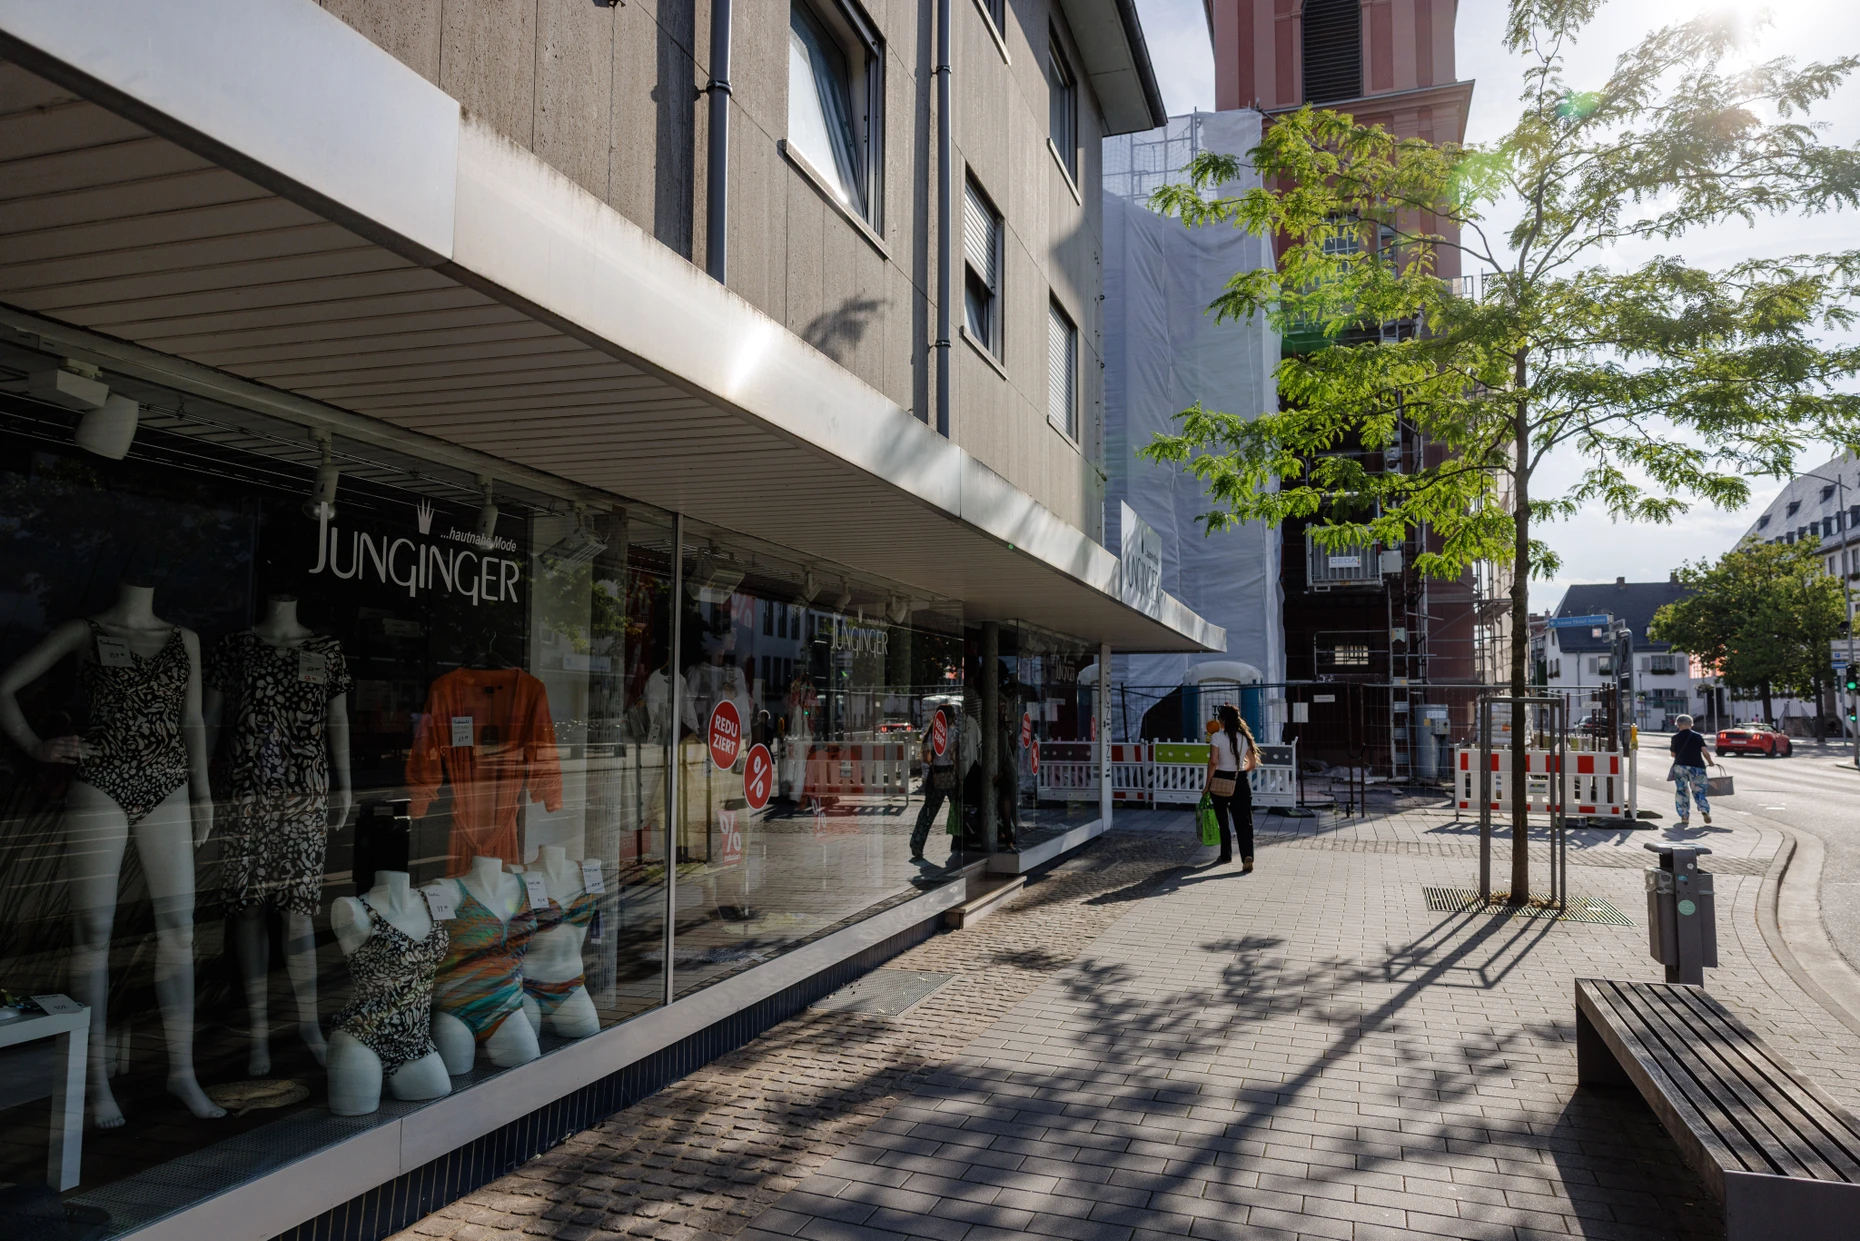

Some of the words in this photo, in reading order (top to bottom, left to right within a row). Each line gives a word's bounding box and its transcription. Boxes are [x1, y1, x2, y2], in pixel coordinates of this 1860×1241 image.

[308, 501, 520, 607] JUNGINGER
[493, 532, 517, 553] Mode
[830, 612, 889, 659] JUNGINGER
[714, 714, 738, 737] REDU
[934, 730, 945, 748] ZIERT
[935, 717, 946, 737] REDU
[712, 733, 736, 756] ZIERT
[749, 755, 768, 800] %
[811, 796, 827, 830] %
[719, 813, 742, 853] %
